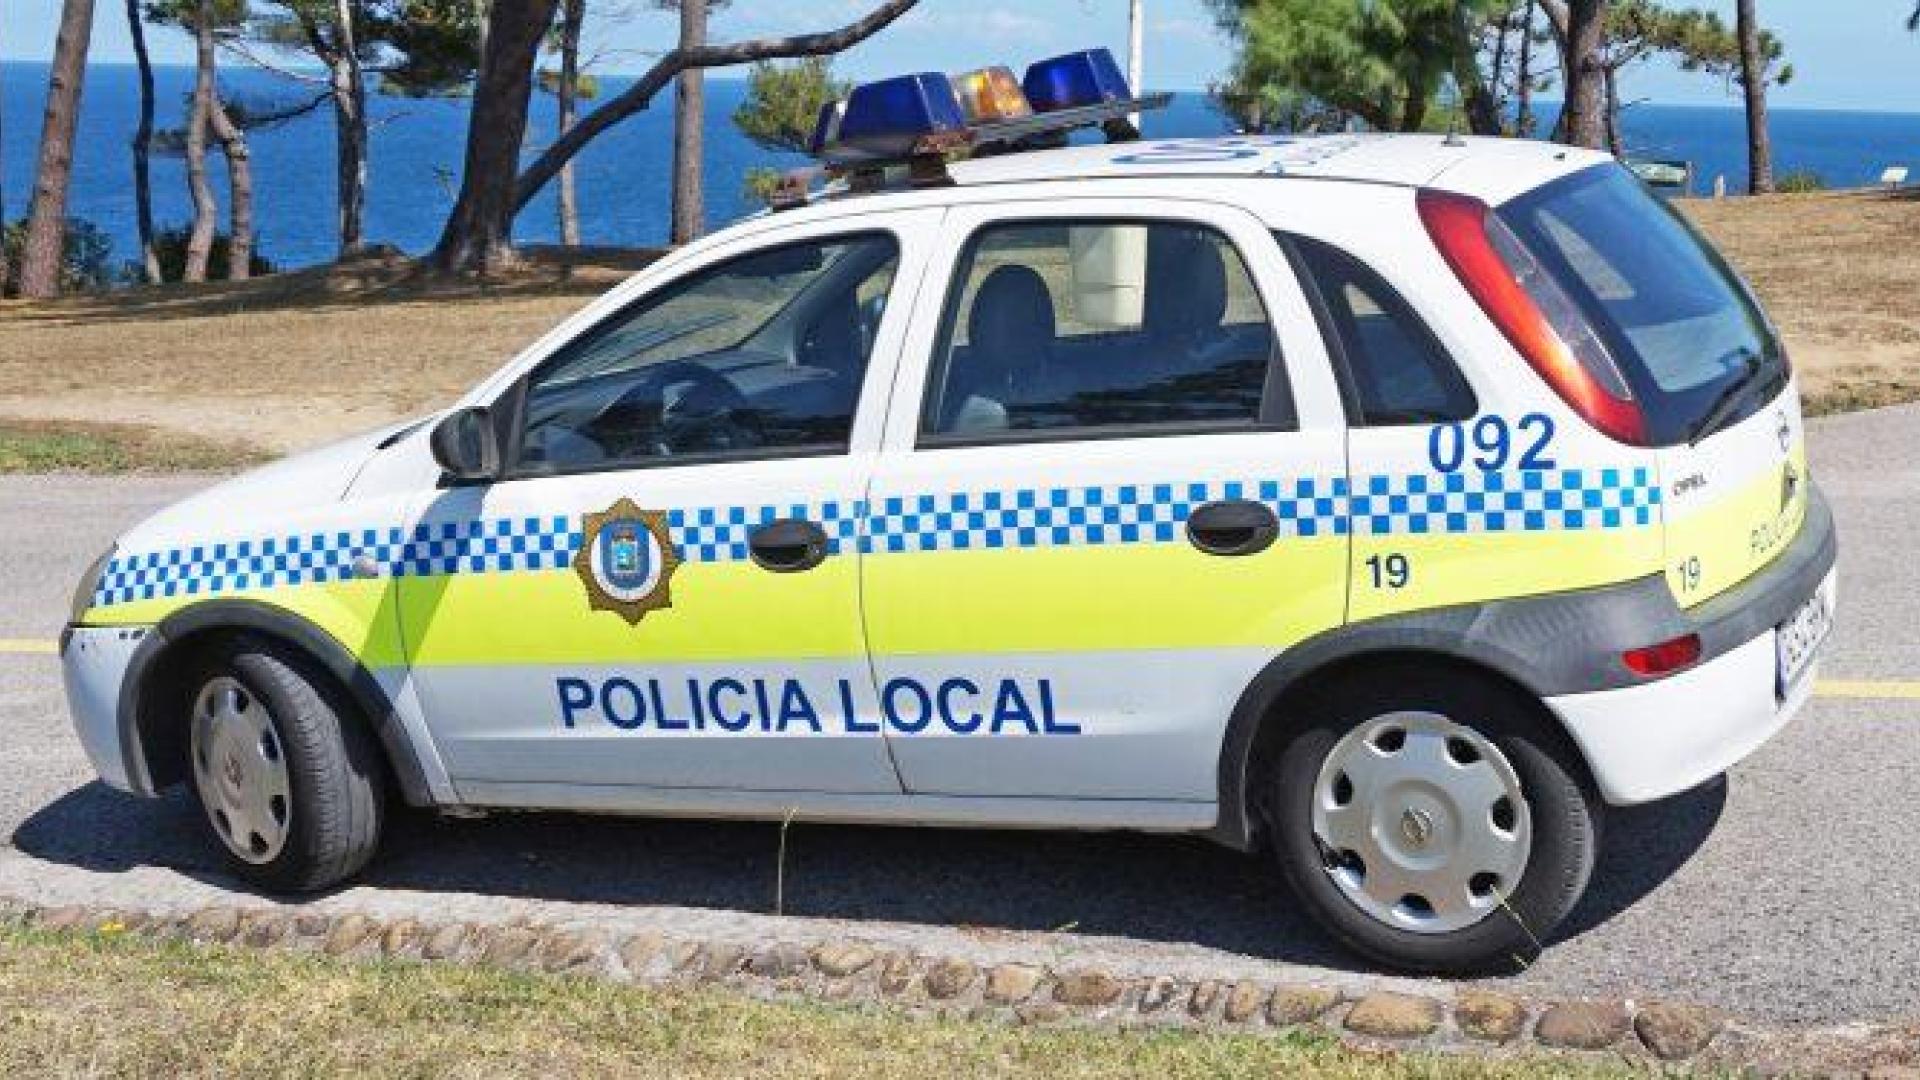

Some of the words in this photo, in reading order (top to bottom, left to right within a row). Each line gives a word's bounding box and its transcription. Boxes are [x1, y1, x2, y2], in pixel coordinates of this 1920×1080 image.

[1428, 413, 1556, 473] 092
[1365, 553, 1409, 588] 19
[1677, 556, 1701, 593] 19
[556, 677, 823, 732] POLICIA
[838, 677, 1082, 735] LOCAL
